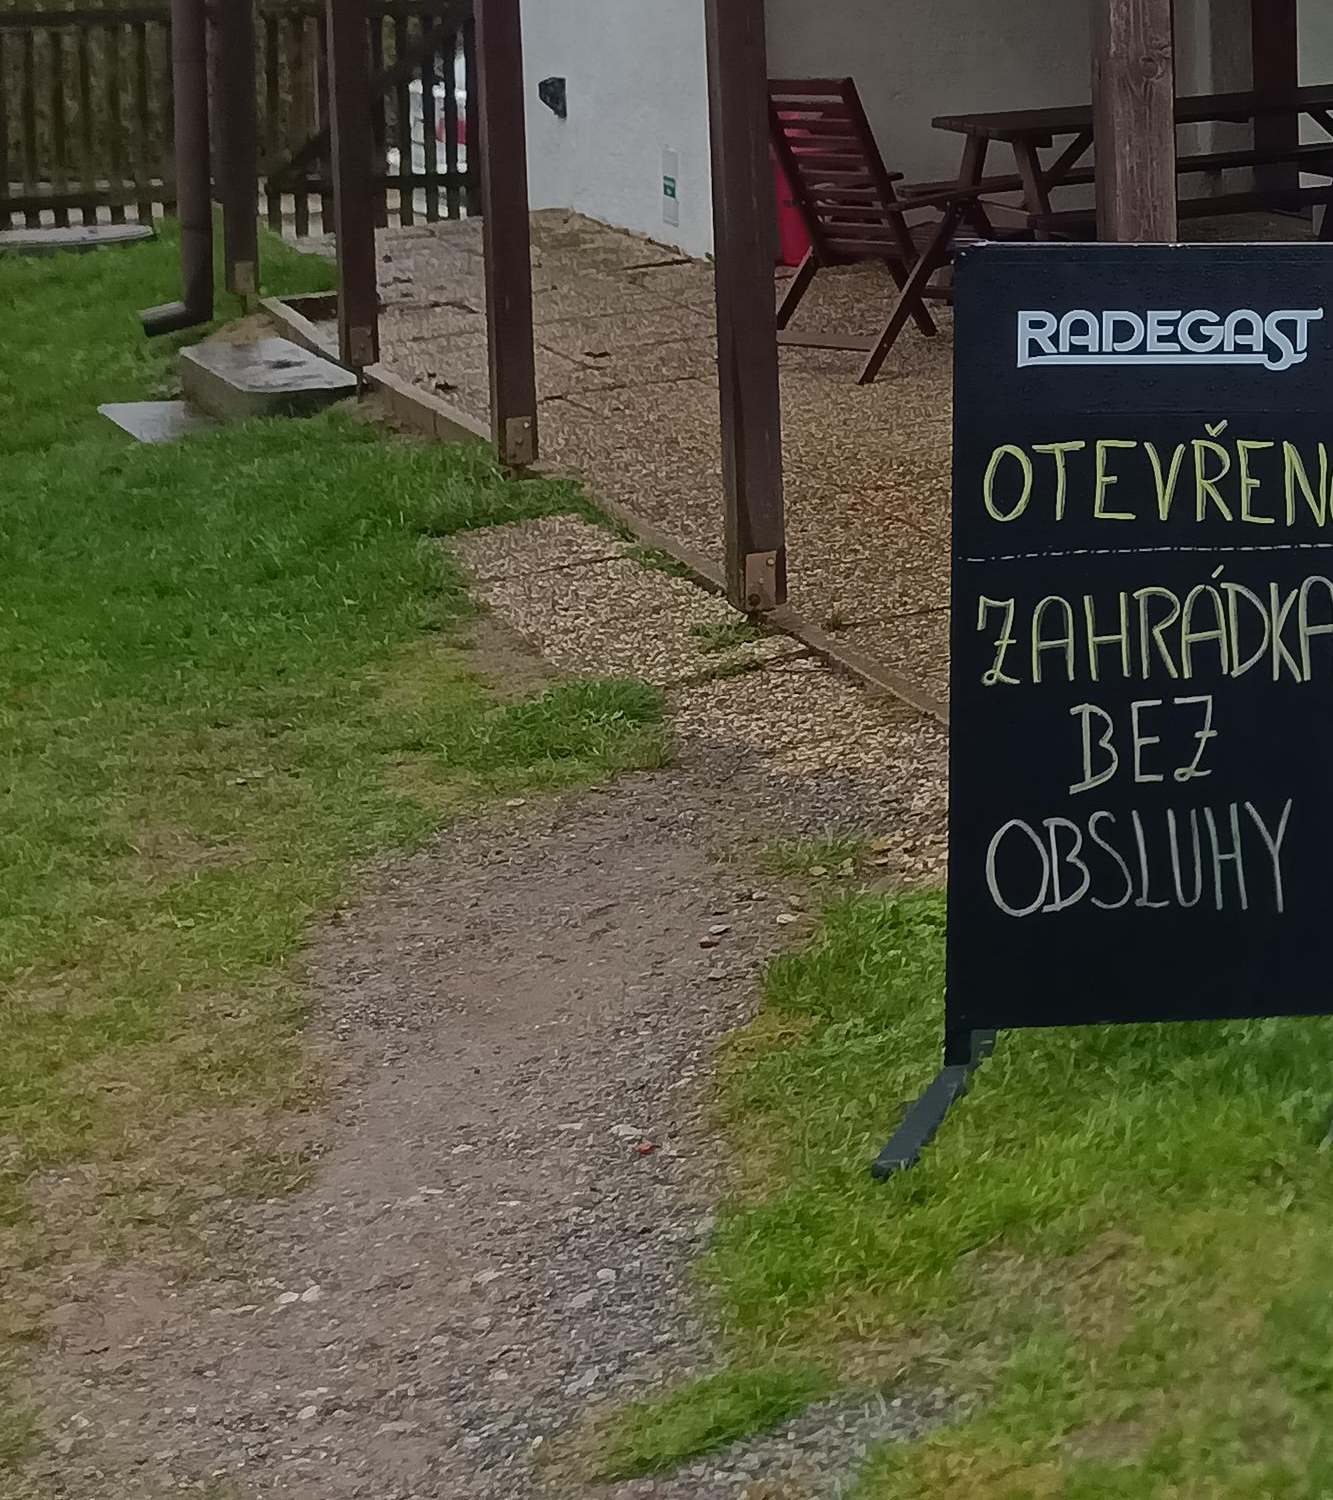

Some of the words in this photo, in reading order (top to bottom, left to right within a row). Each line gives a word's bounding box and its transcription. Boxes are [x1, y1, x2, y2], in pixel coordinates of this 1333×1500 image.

[1017, 307, 1324, 371] RADEGAST
[1069, 694, 1218, 794] BEZ
[985, 798, 1293, 917] OBSLUHY
